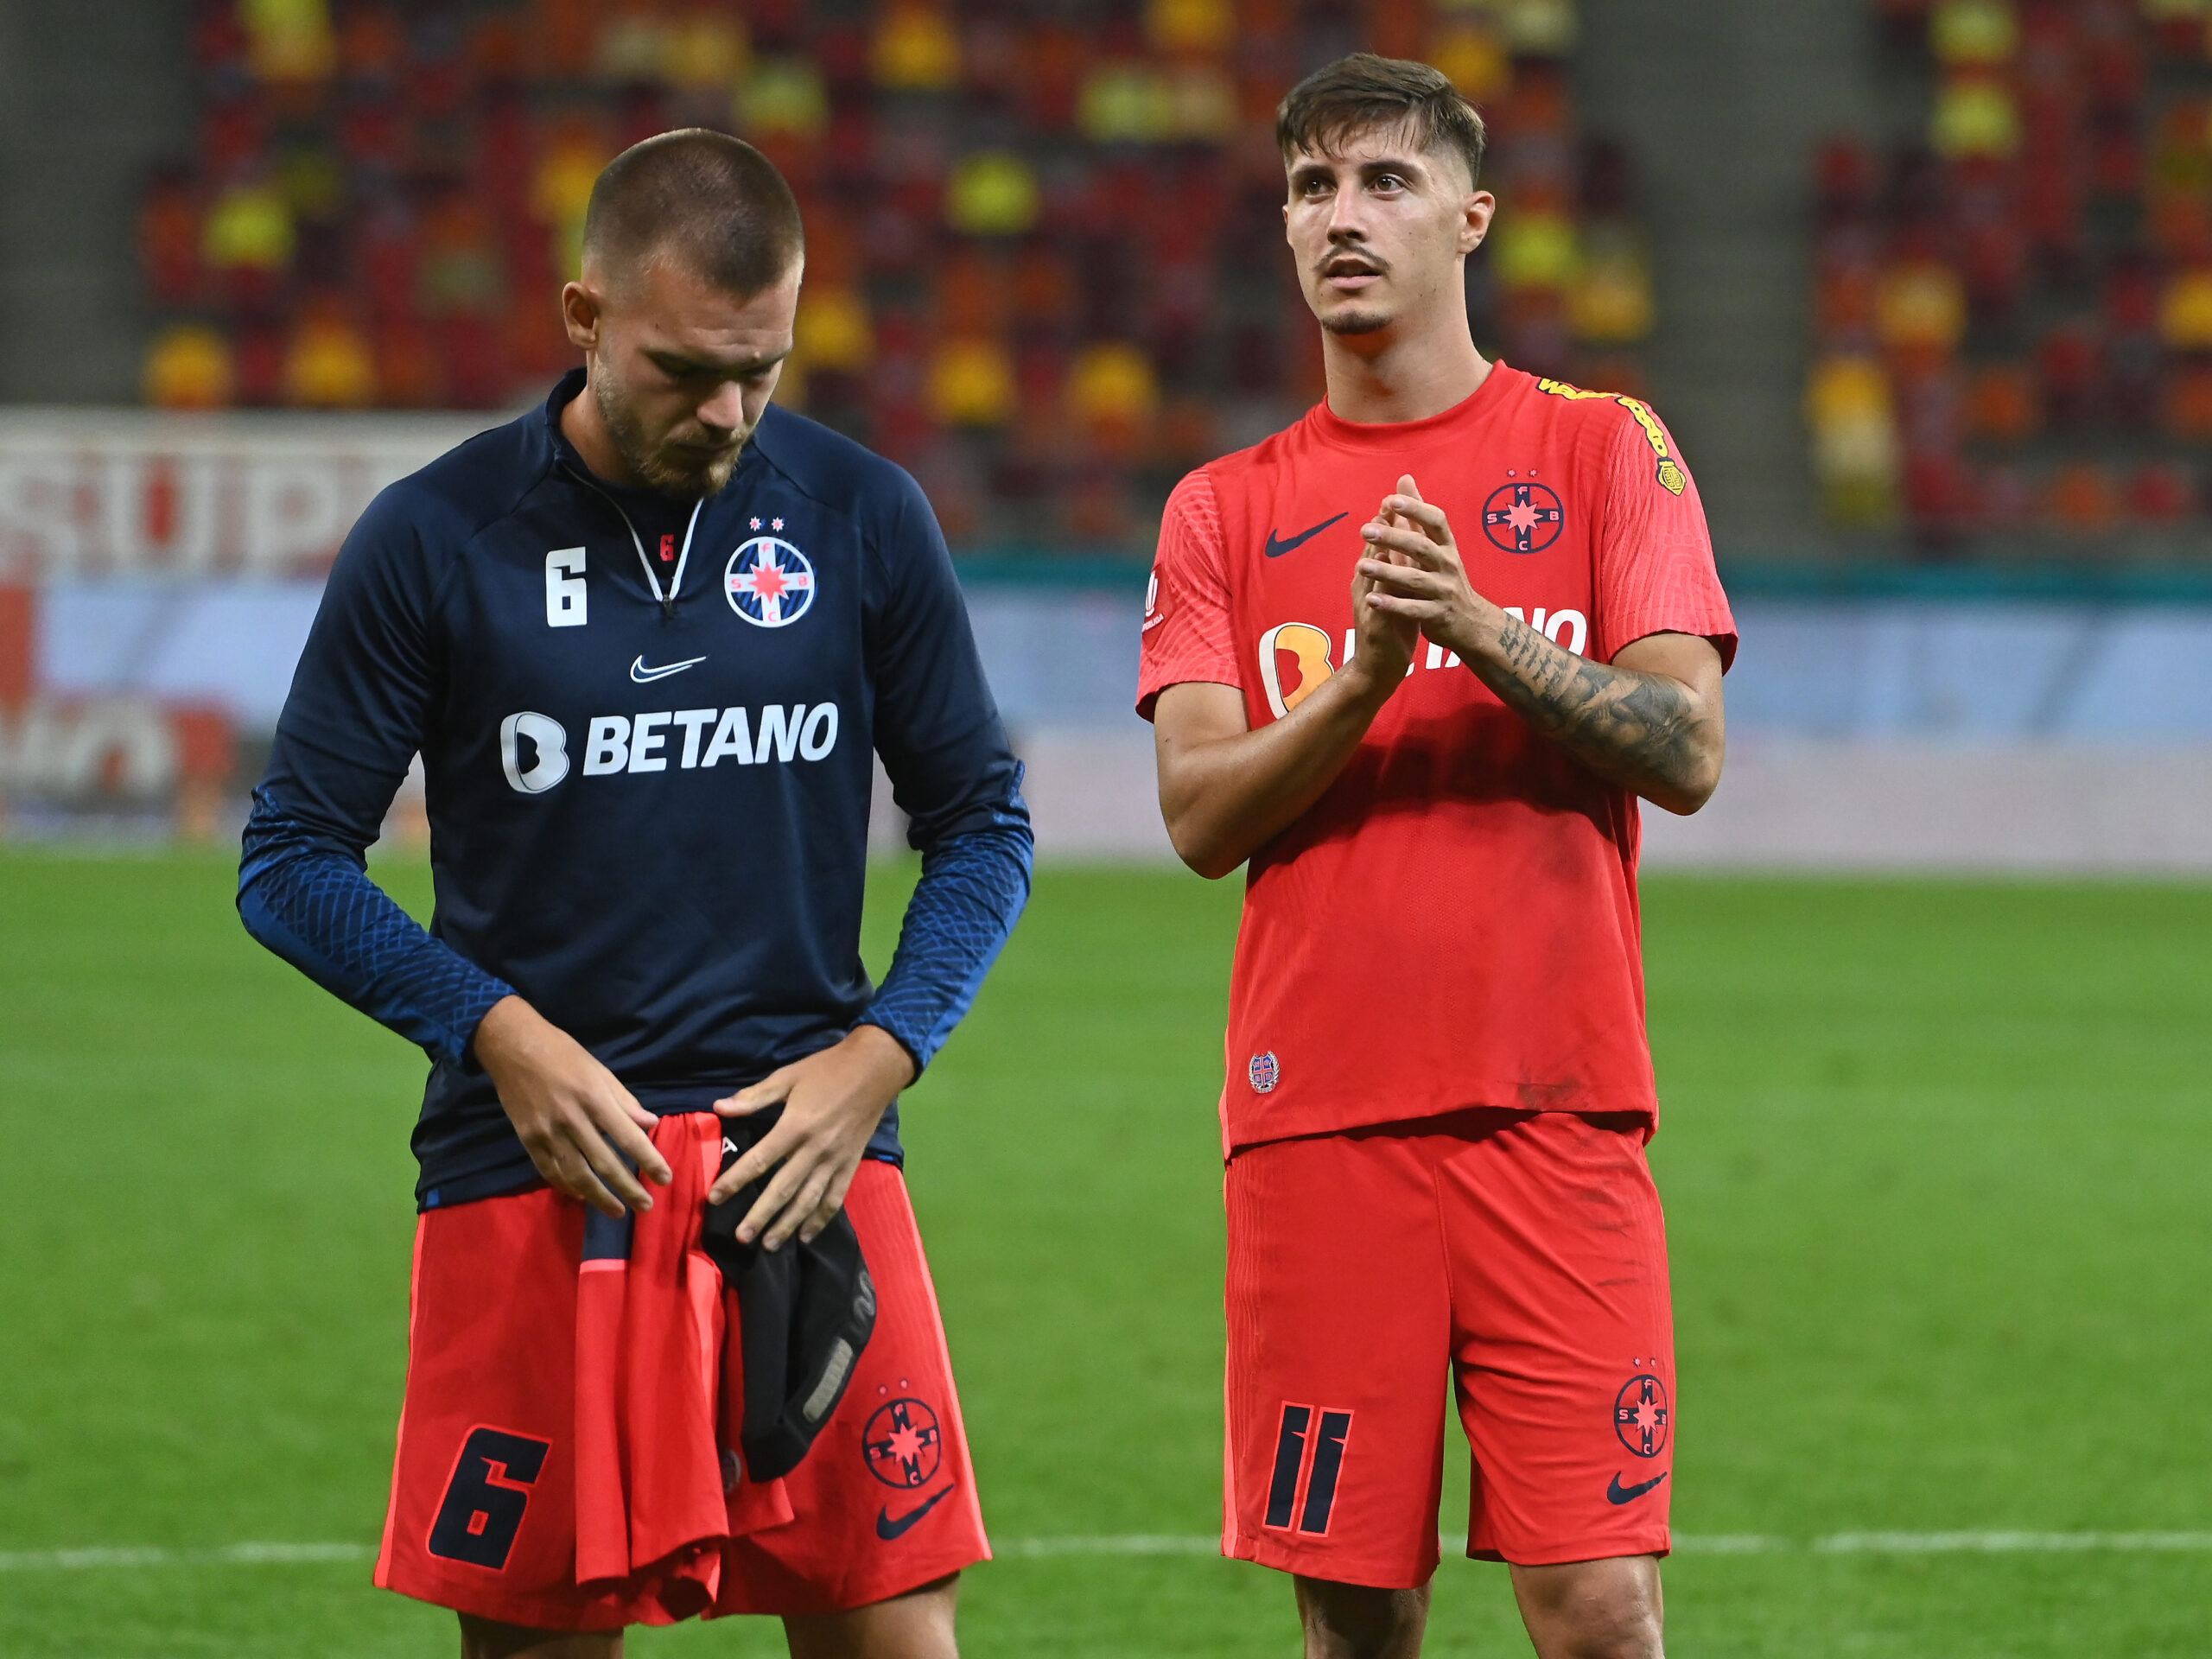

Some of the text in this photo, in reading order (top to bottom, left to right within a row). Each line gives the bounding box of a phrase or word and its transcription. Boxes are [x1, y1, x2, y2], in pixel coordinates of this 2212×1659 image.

[1487, 511, 1560, 524] S B
[659, 534, 674, 562] 6
[761, 543, 772, 553] F
[1518, 540, 1529, 550] C
[545, 546, 588, 627] 6
[731, 575, 809, 589] S B
[767, 611, 778, 622] C
[582, 702, 839, 776] BETANO
[1618, 1408, 1629, 1421] S
[1643, 1443, 1651, 1455] C
[1261, 1400, 1355, 1538] 11
[909, 1471, 919, 1485] C
[426, 1422, 553, 1571] 6
